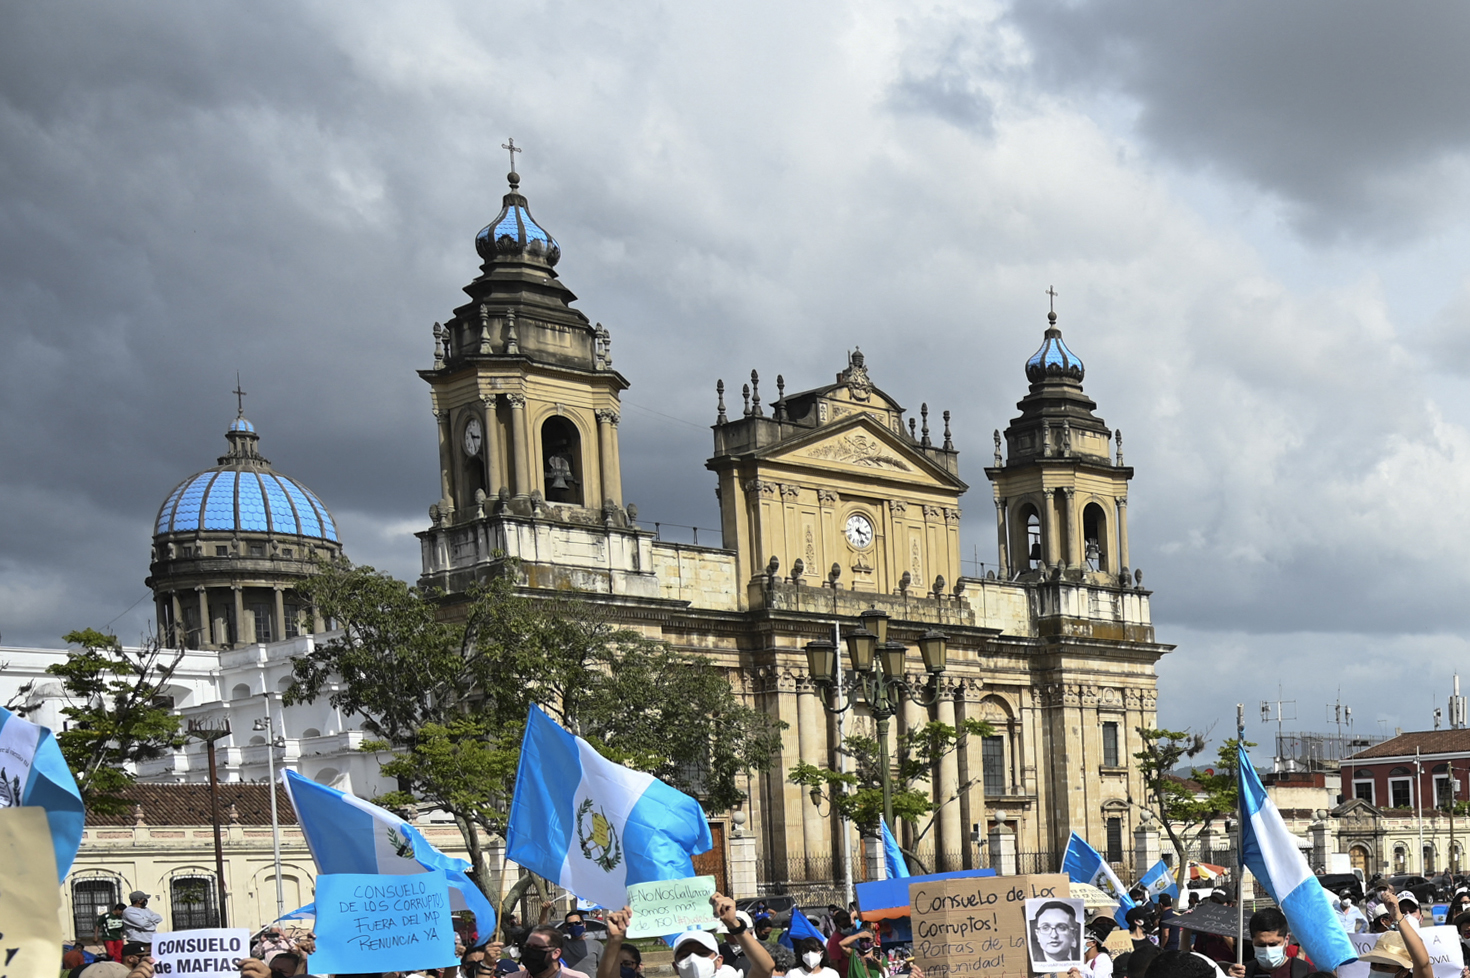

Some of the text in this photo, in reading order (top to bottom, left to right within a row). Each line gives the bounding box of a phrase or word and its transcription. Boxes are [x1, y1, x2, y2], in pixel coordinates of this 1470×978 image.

[354, 881, 426, 899] CONSUELO
[1006, 886, 1026, 903] de
[339, 901, 359, 914] DE
[394, 892, 445, 912] CORRUPTOS
[402, 913, 421, 927] DEL
[425, 911, 441, 925] MP
[424, 927, 441, 941] YA
[158, 937, 241, 956] CONSUELO
[981, 936, 1004, 952] de
[153, 957, 243, 975] de MAFIAS
